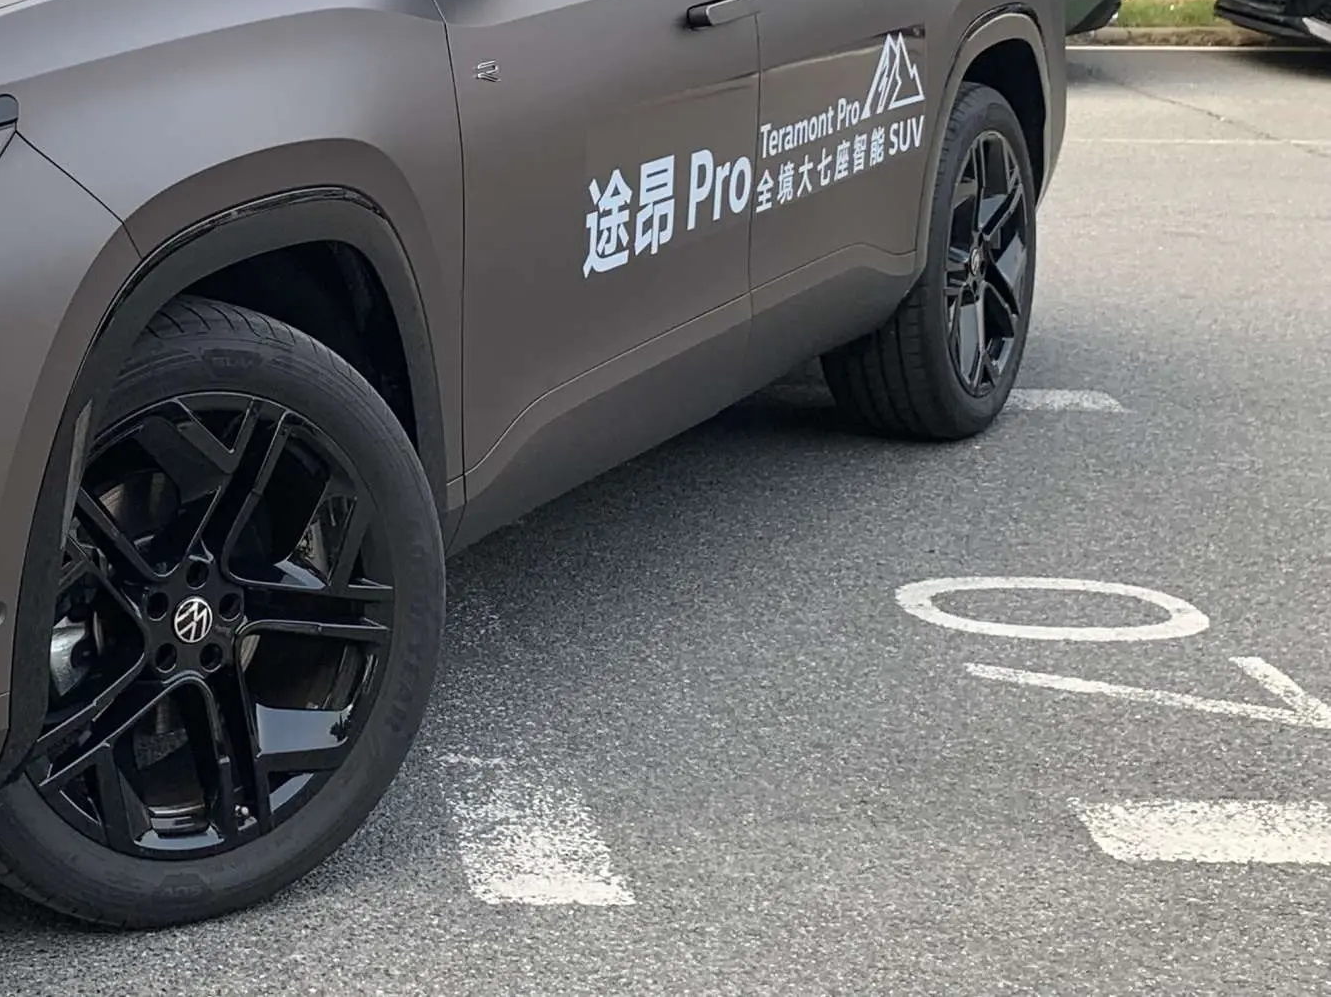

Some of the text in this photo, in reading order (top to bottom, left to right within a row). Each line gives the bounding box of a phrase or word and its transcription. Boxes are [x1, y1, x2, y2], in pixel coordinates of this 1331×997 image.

[756, 116, 924, 213] 全境大七座智能 SUV
[760, 98, 860, 158] Teramont Pro
[583, 149, 752, 278] 途昂 Pro
